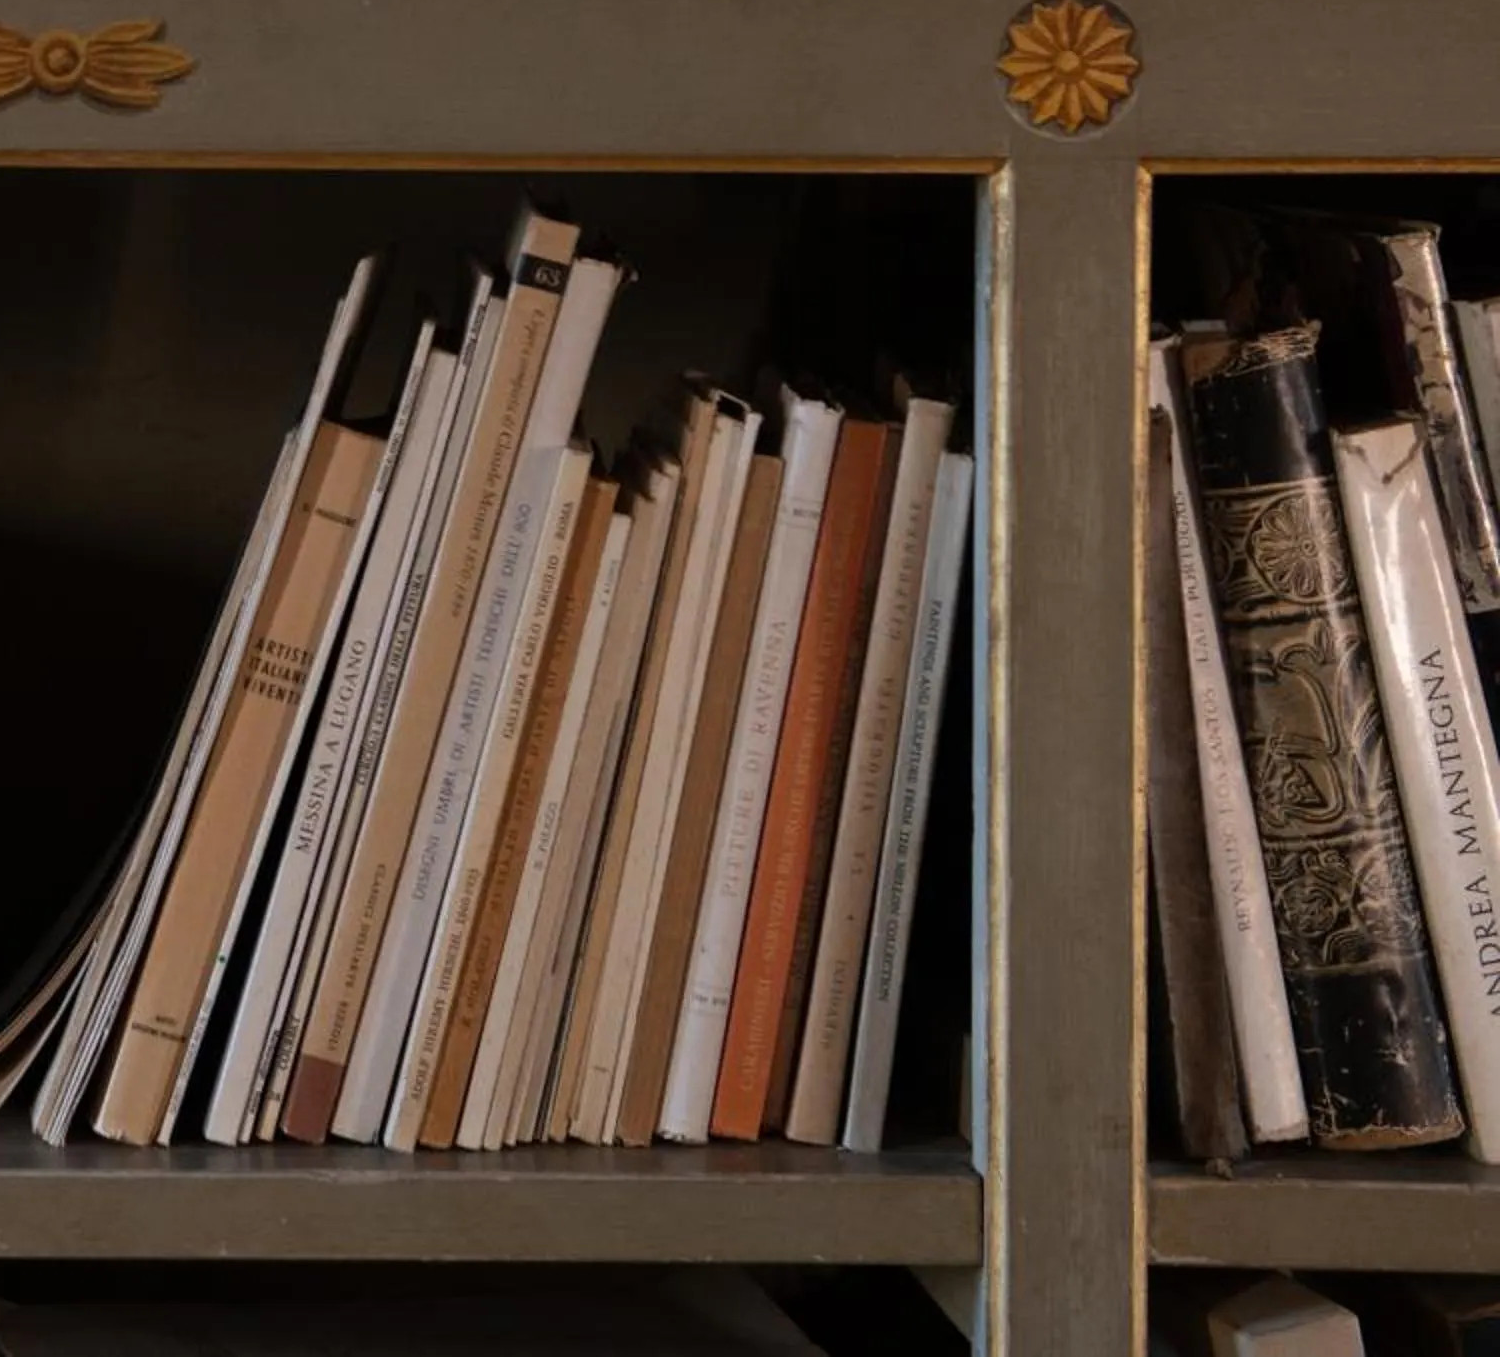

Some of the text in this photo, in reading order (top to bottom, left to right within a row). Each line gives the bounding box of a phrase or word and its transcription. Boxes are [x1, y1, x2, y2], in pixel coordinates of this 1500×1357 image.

[483, 428, 515, 490] Claude
[248, 655, 307, 684] ITALIANI
[254, 637, 313, 666] ARTISTI
[243, 674, 301, 705] VIVENTI
[455, 670, 487, 734] ARTISTI
[292, 637, 369, 855] MESSINA A LUGANO
[447, 738, 468, 763] DI
[716, 616, 791, 899] PITTURE DI RAVENNA
[1199, 686, 1228, 770] SANTOS
[1415, 646, 1483, 861] MANTEGNA
[408, 832, 443, 903] DISEGNI
